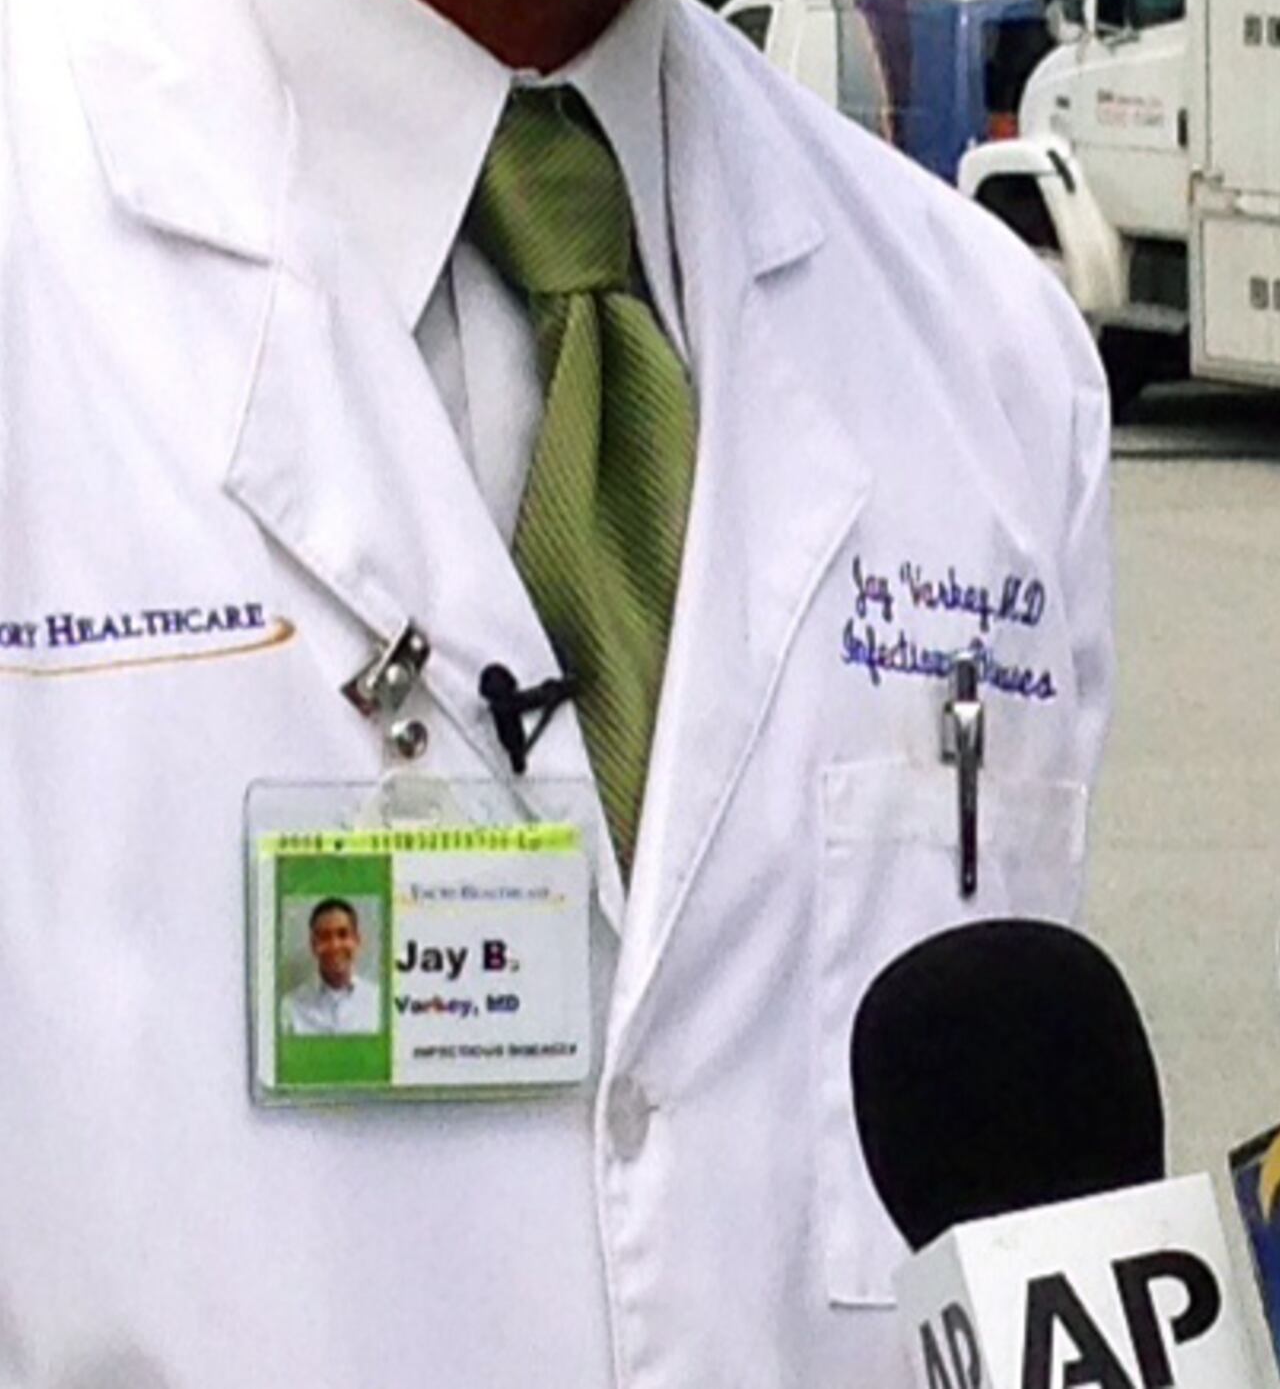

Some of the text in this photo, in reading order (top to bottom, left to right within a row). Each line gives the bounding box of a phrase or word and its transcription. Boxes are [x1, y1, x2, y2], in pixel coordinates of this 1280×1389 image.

[45, 603, 266, 647] HEALTHCARE
[395, 939, 468, 982] Jay
[485, 993, 521, 1013] MD
[1022, 1248, 1221, 1389] AP
[919, 1300, 982, 1389] AP
